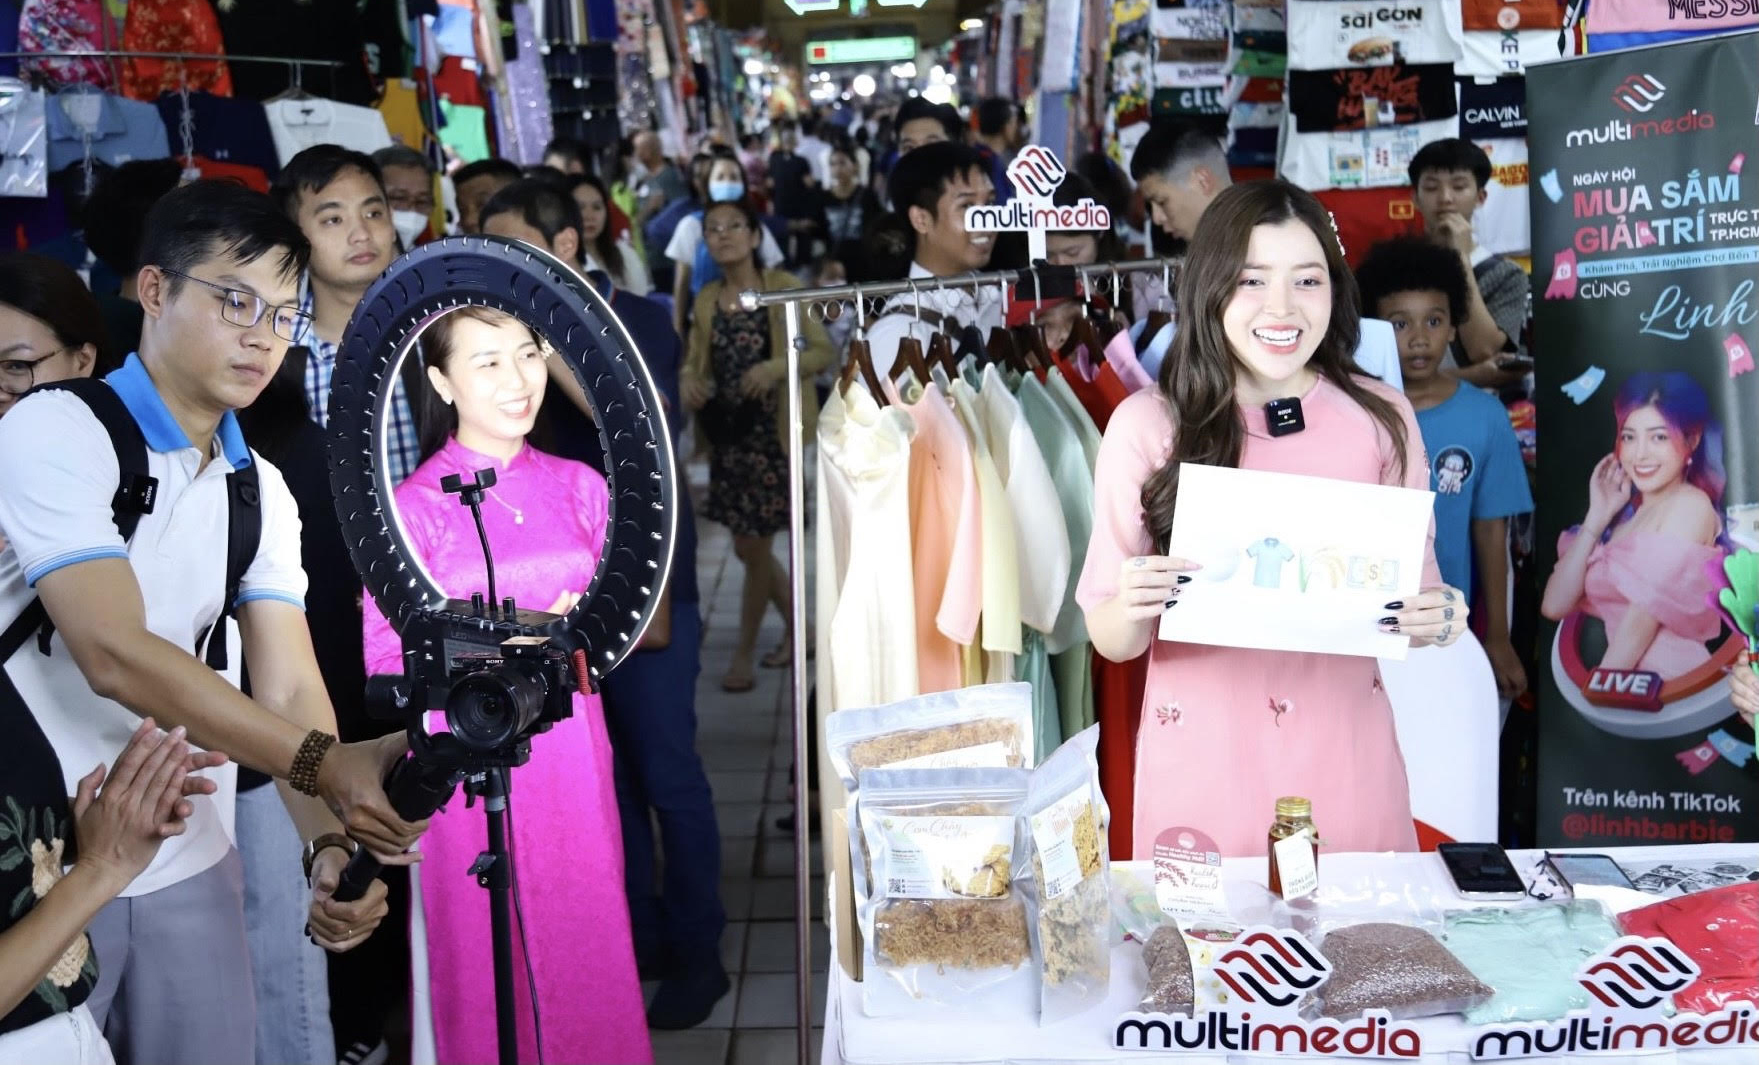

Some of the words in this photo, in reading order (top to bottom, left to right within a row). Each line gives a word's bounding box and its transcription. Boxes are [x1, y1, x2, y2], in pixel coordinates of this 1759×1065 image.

[1465, 105, 1520, 124] CALVIN
[1566, 108, 1715, 148] multimedia
[1573, 170, 1609, 187] NGÀY
[1612, 166, 1636, 183] HỘI
[1573, 184, 1653, 219] MUA
[1661, 168, 1741, 210] SẮM
[971, 202, 1109, 229] multimedia
[1651, 208, 1706, 247] TRÍ
[1709, 209, 1748, 226] TRỰC
[1584, 263, 1614, 275] Khám
[1662, 256, 1701, 271] Nghiệm
[1580, 279, 1631, 299] CÙNG
[1639, 279, 1759, 341] Linh
[1587, 671, 1652, 696] LIVE
[1563, 787, 1608, 807] Trên
[1613, 789, 1665, 809] kênh
[1670, 792, 1741, 813] TikTok
[1562, 811, 1736, 842] @linhbarbie
[1116, 1011, 1420, 1057] multimedia
